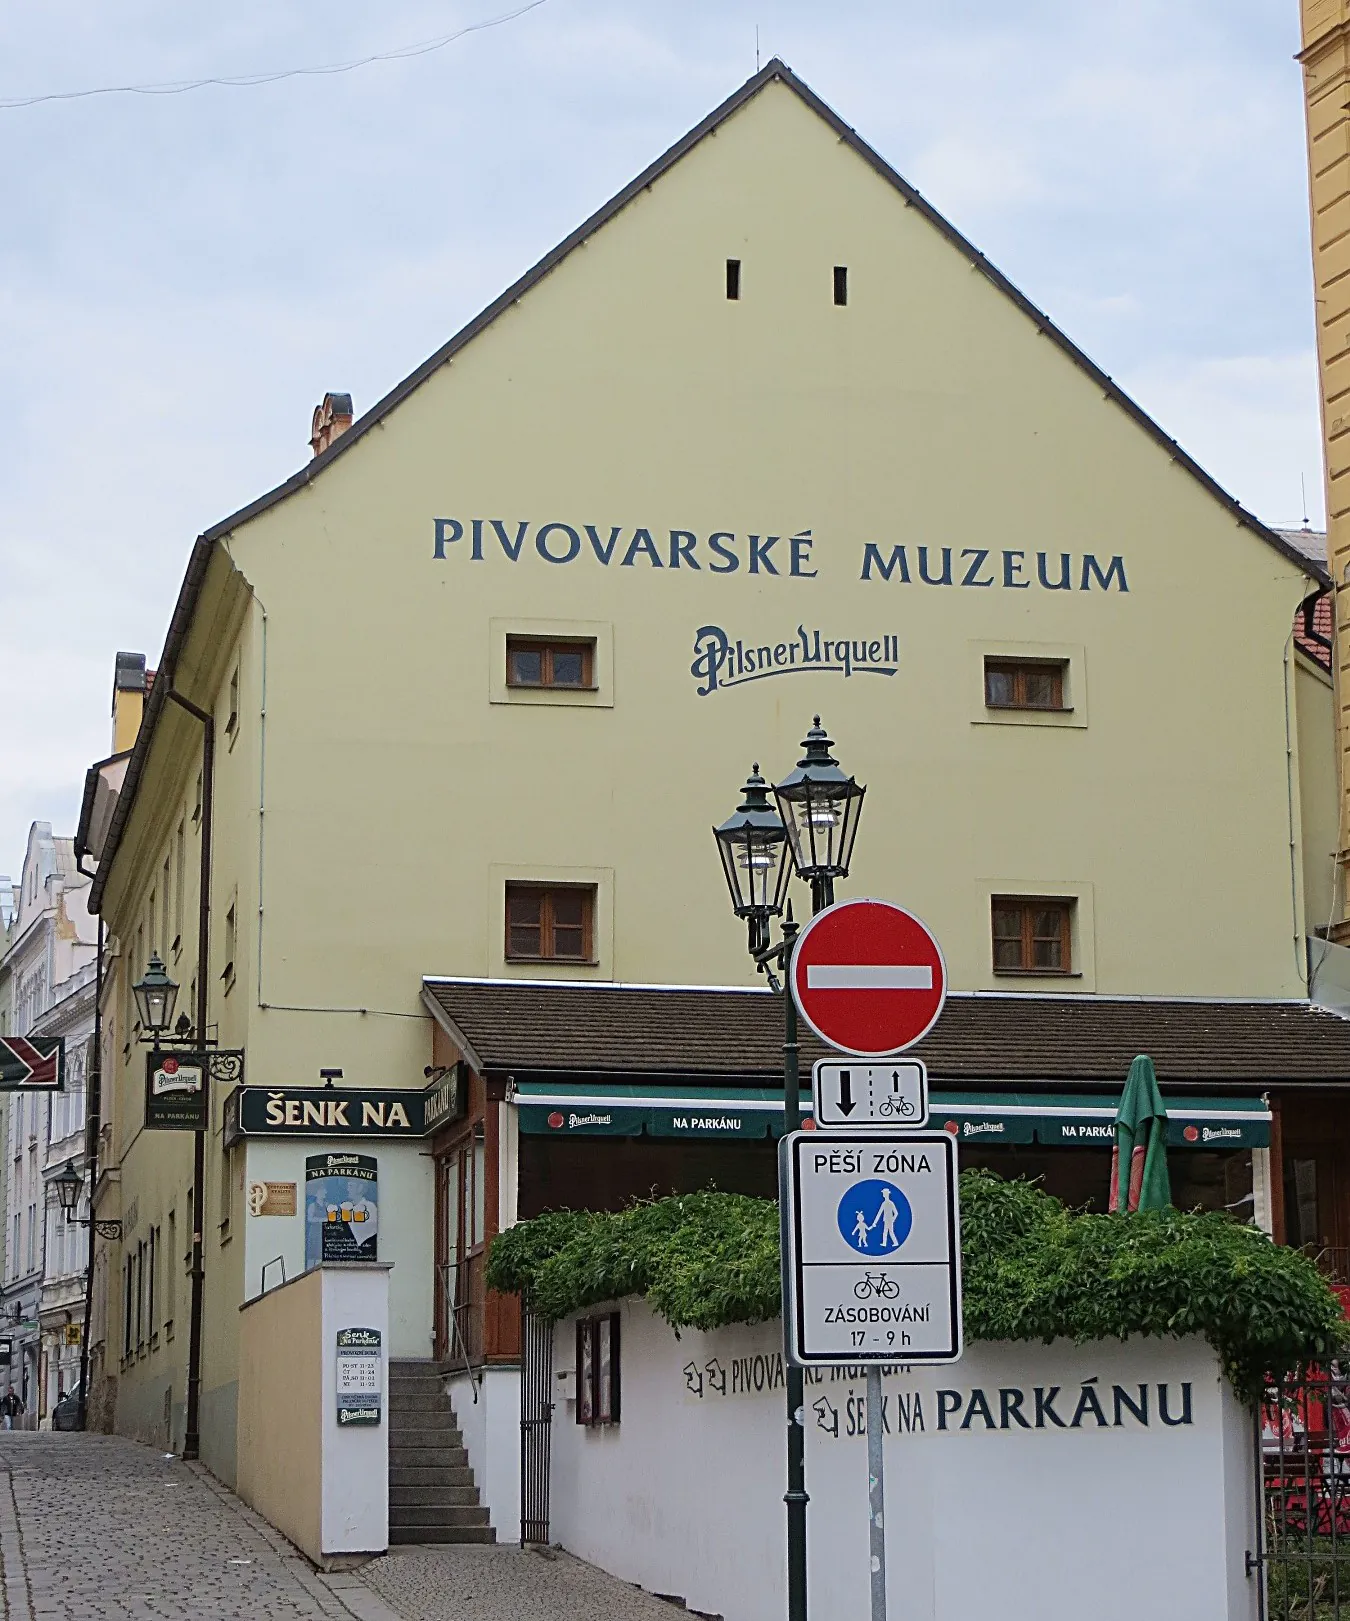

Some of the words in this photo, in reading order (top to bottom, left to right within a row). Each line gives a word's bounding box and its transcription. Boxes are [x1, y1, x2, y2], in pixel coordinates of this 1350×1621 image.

[432, 518, 819, 577] PIVOVARSKÉ
[859, 543, 1130, 592] MUZEUM
[690, 625, 799, 697] Pilsner
[797, 624, 899, 678] Urquell
[167, 1112, 200, 1120] PARKÁNU
[265, 1092, 350, 1126] ŠENK
[361, 1102, 412, 1127] NA
[568, 1113, 591, 1128] Pilsner
[589, 1113, 612, 1125] Urquell
[673, 1117, 688, 1129] NA
[691, 1116, 741, 1130] PARKÁNU
[1062, 1126, 1077, 1137] NA
[1079, 1124, 1115, 1137] PARKÁ
[814, 1149, 863, 1174] PĚŠÍ
[873, 1149, 932, 1173] ZÓNA
[311, 1169, 325, 1178] NA
[328, 1167, 373, 1179] PARKÁNU
[824, 1304, 931, 1323] ZÁSOBOVÁNÍ
[850, 1331, 866, 1346] 17
[886, 1331, 895, 1346] 9
[901, 1331, 911, 1346] h
[846, 1389, 891, 1437] ŠEK
[898, 1392, 925, 1435] NA
[936, 1376, 1194, 1430] PARKÁNU
